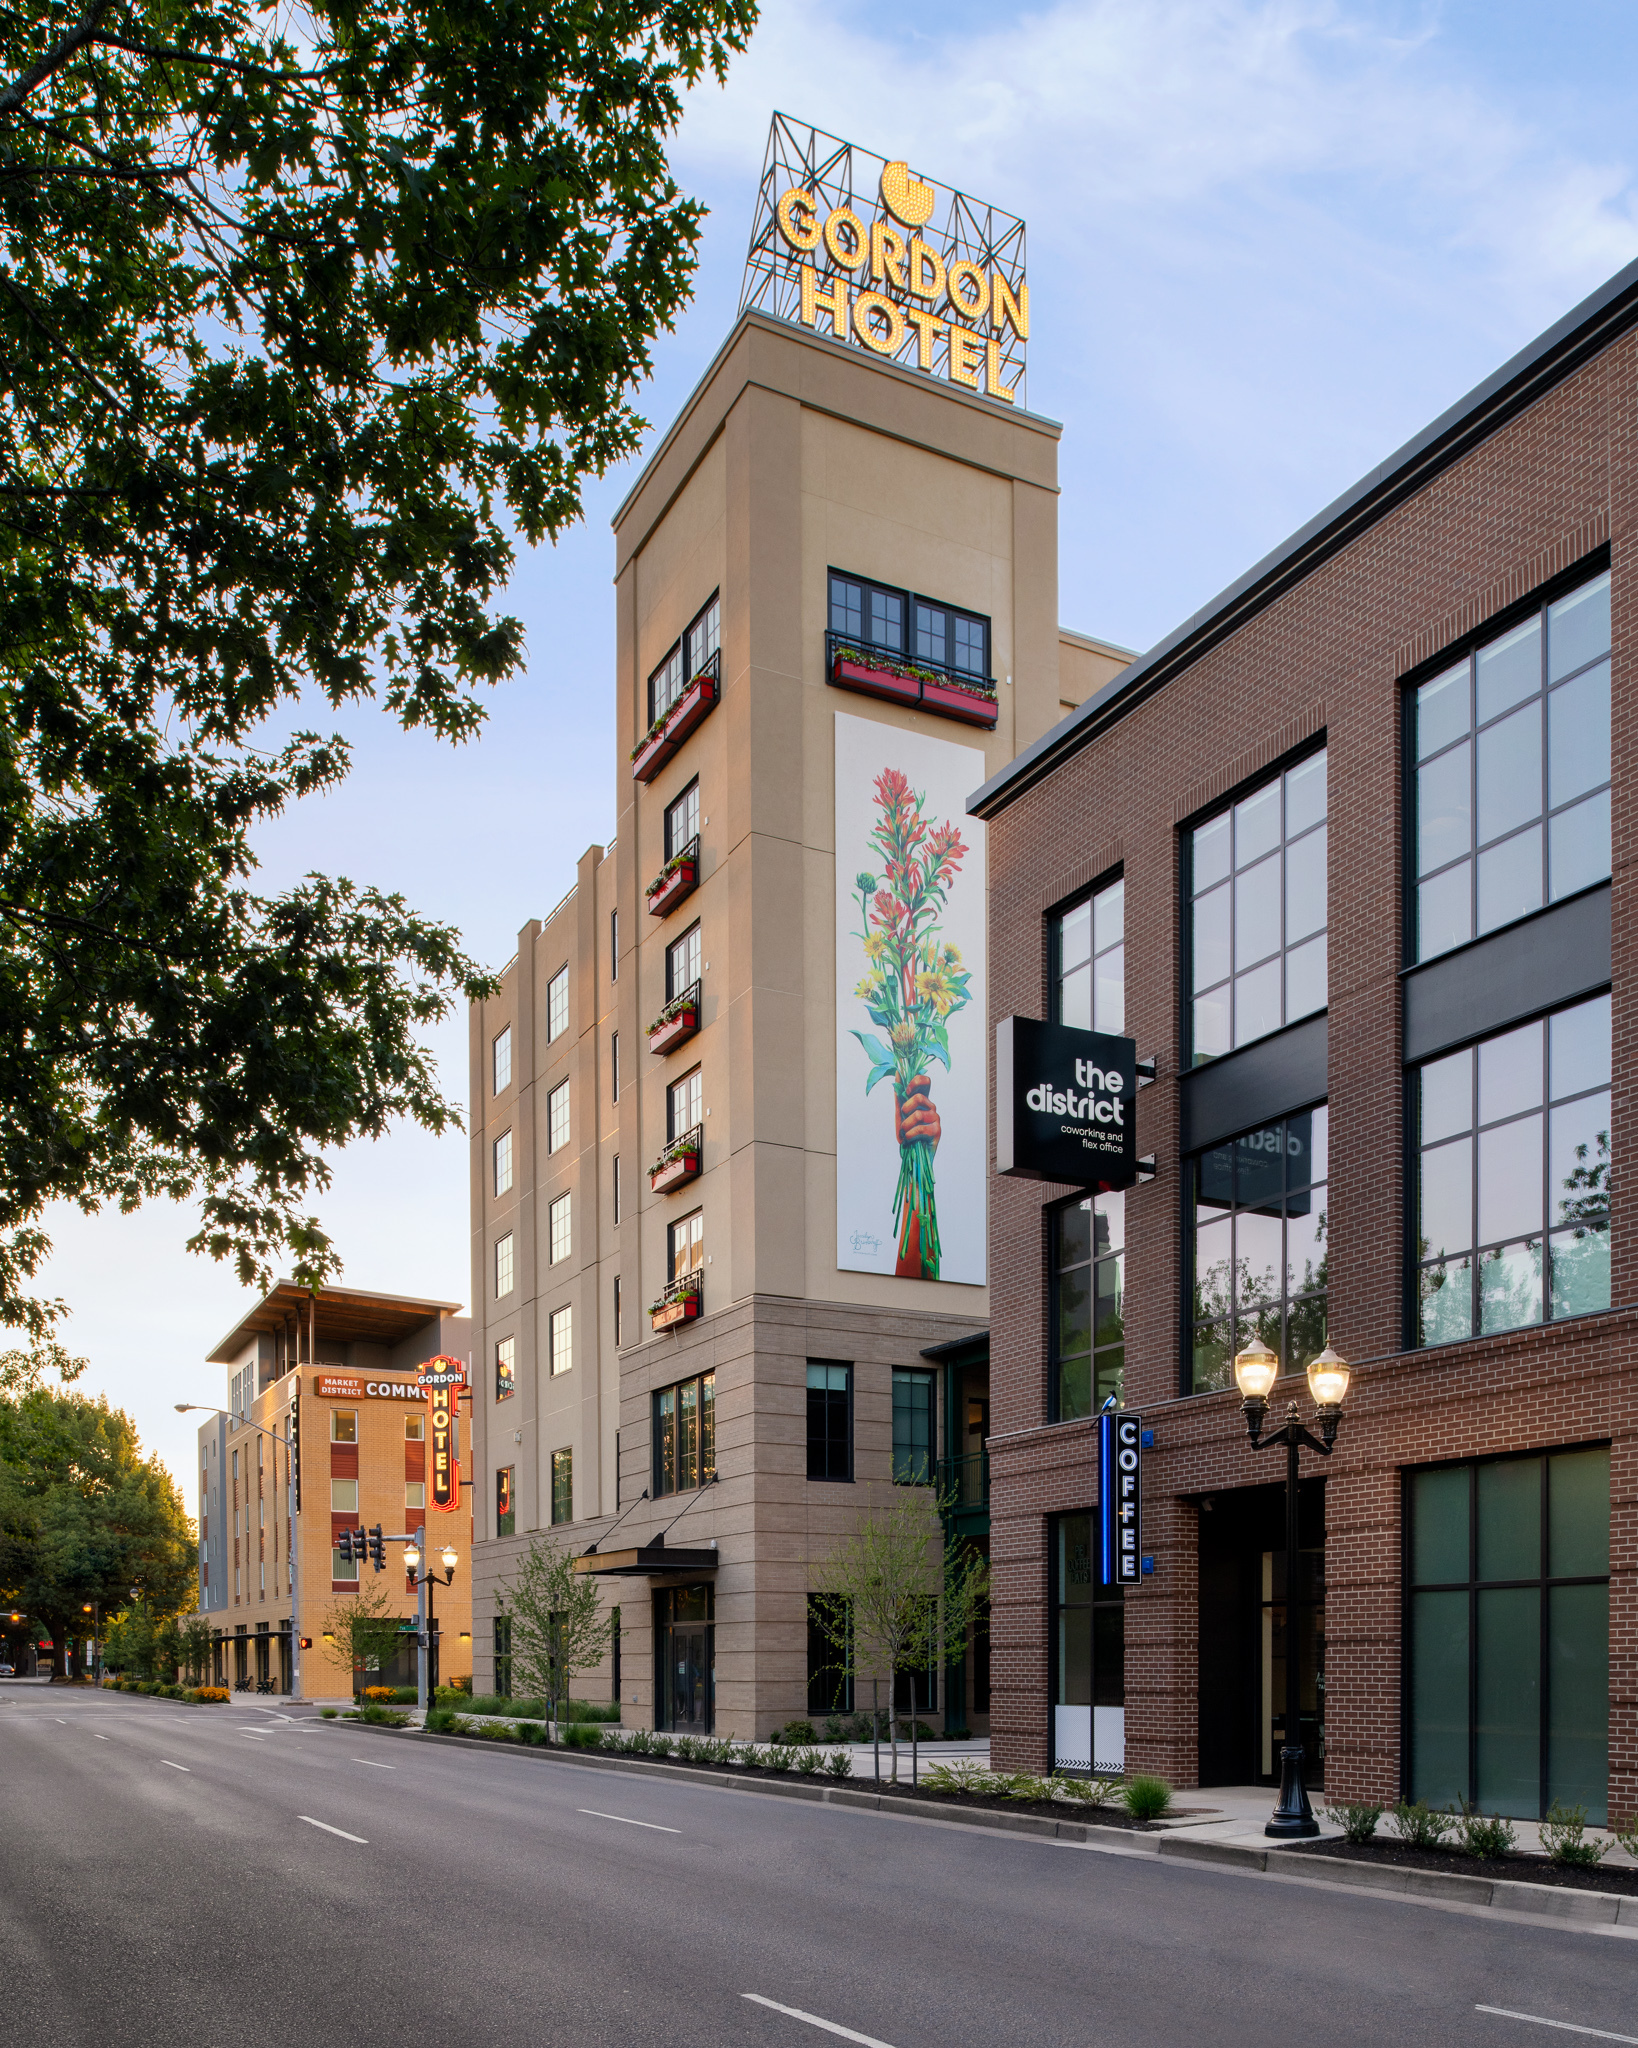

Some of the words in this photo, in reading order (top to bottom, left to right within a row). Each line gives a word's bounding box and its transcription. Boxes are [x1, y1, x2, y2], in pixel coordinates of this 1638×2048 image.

[777, 187, 1029, 342] GORDON
[800, 264, 1015, 404] HOTEL
[1075, 1058, 1124, 1093] the
[1026, 1083, 1124, 1126] district
[1060, 1125, 1106, 1140] coworking
[1107, 1132, 1123, 1142] and
[1082, 1138, 1098, 1149] flex
[1099, 1143, 1124, 1154] office
[321, 1386, 362, 1395] DISTRICT
[324, 1378, 358, 1387] MARKET
[418, 1374, 462, 1384] GORDON
[433, 1389, 449, 1491] HOTEL
[1118, 1421, 1138, 1577] COFFEE
